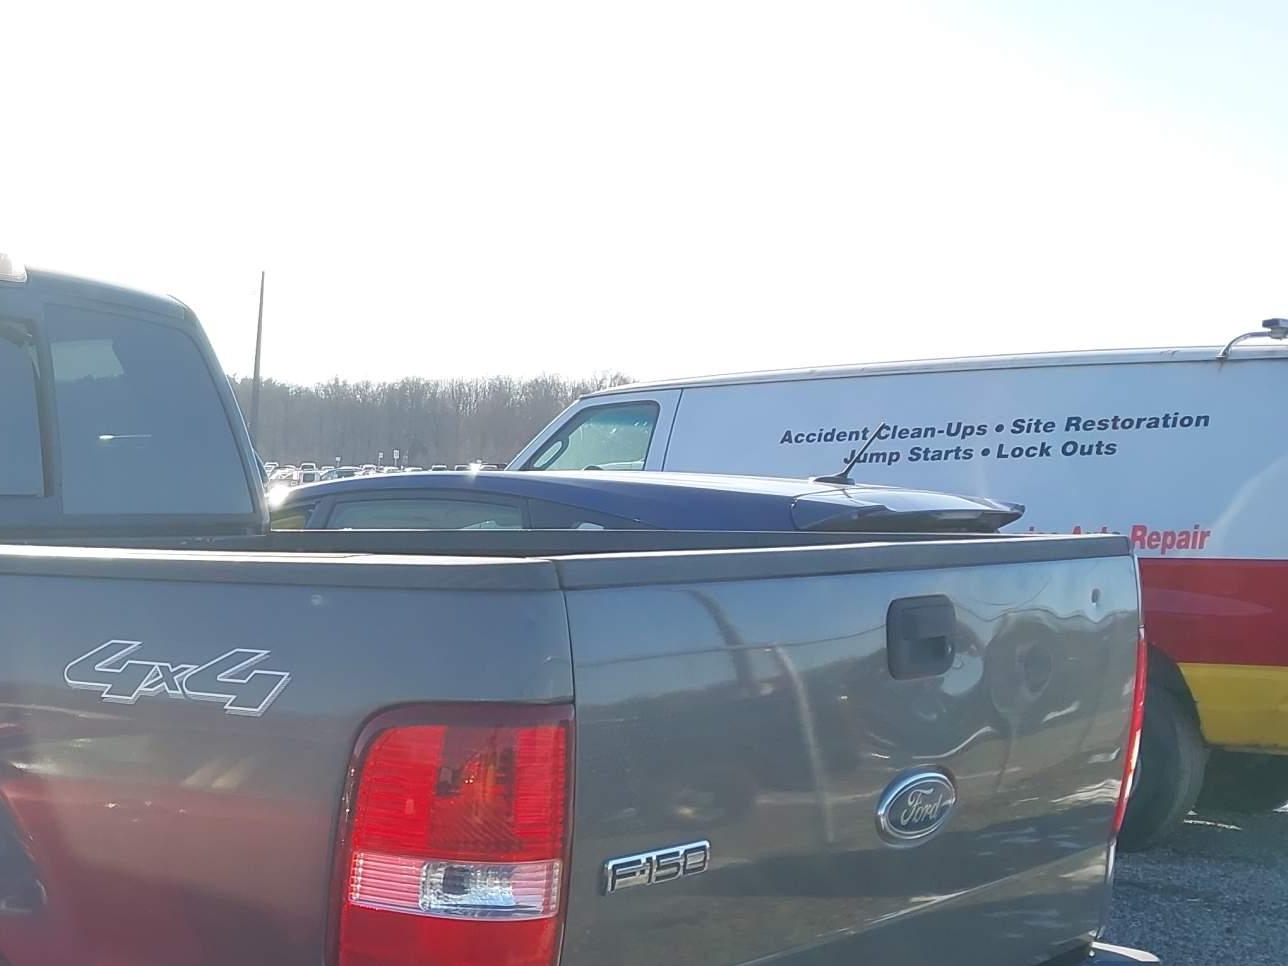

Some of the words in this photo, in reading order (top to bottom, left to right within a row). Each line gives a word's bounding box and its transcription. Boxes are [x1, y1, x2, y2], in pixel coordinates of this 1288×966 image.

[779, 427, 870, 444] Accident
[876, 421, 988, 440] Clean-Ups
[1010, 418, 1056, 435] Site
[1064, 412, 1211, 432] Restoration
[843, 449, 901, 465] Jump
[907, 446, 974, 462] Starts
[996, 441, 1053, 459] Lock
[1060, 440, 1118, 457] Outs
[1130, 523, 1211, 555] Repair
[64, 639, 292, 717] 4x4
[900, 787, 943, 826] Ford
